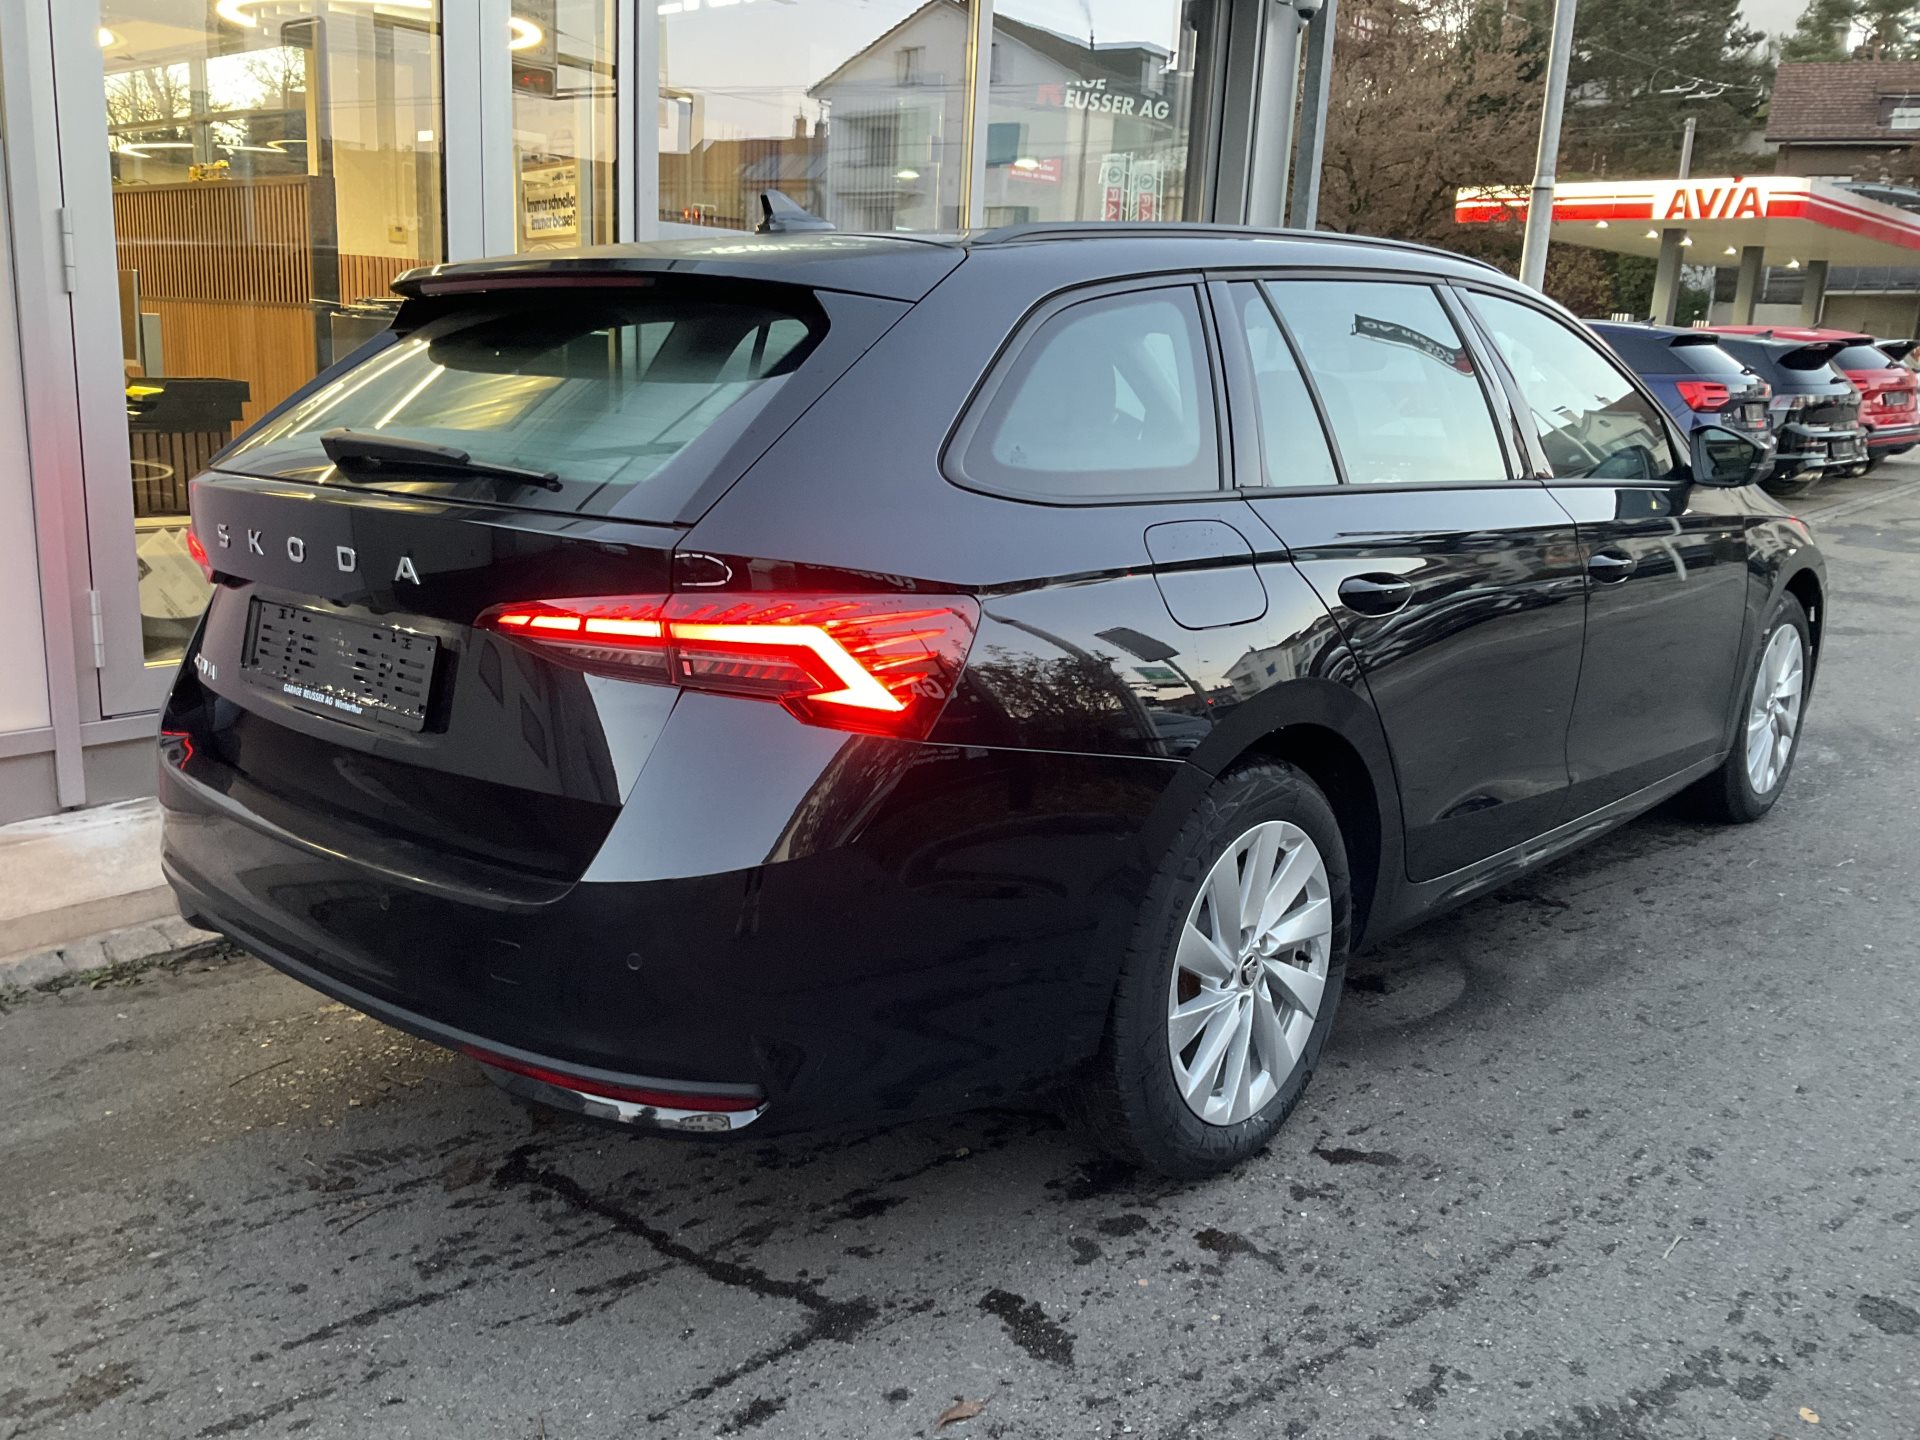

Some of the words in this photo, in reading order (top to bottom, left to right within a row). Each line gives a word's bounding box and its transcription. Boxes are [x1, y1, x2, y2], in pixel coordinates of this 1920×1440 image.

[1138, 99, 1169, 120] AG
[1664, 176, 1764, 219] AVIA
[217, 523, 421, 585] SKODA
[283, 683, 303, 697] GARAGE
[303, 689, 325, 704] REUSSER
[325, 695, 334, 706] AG
[335, 699, 363, 715] Winterthur
